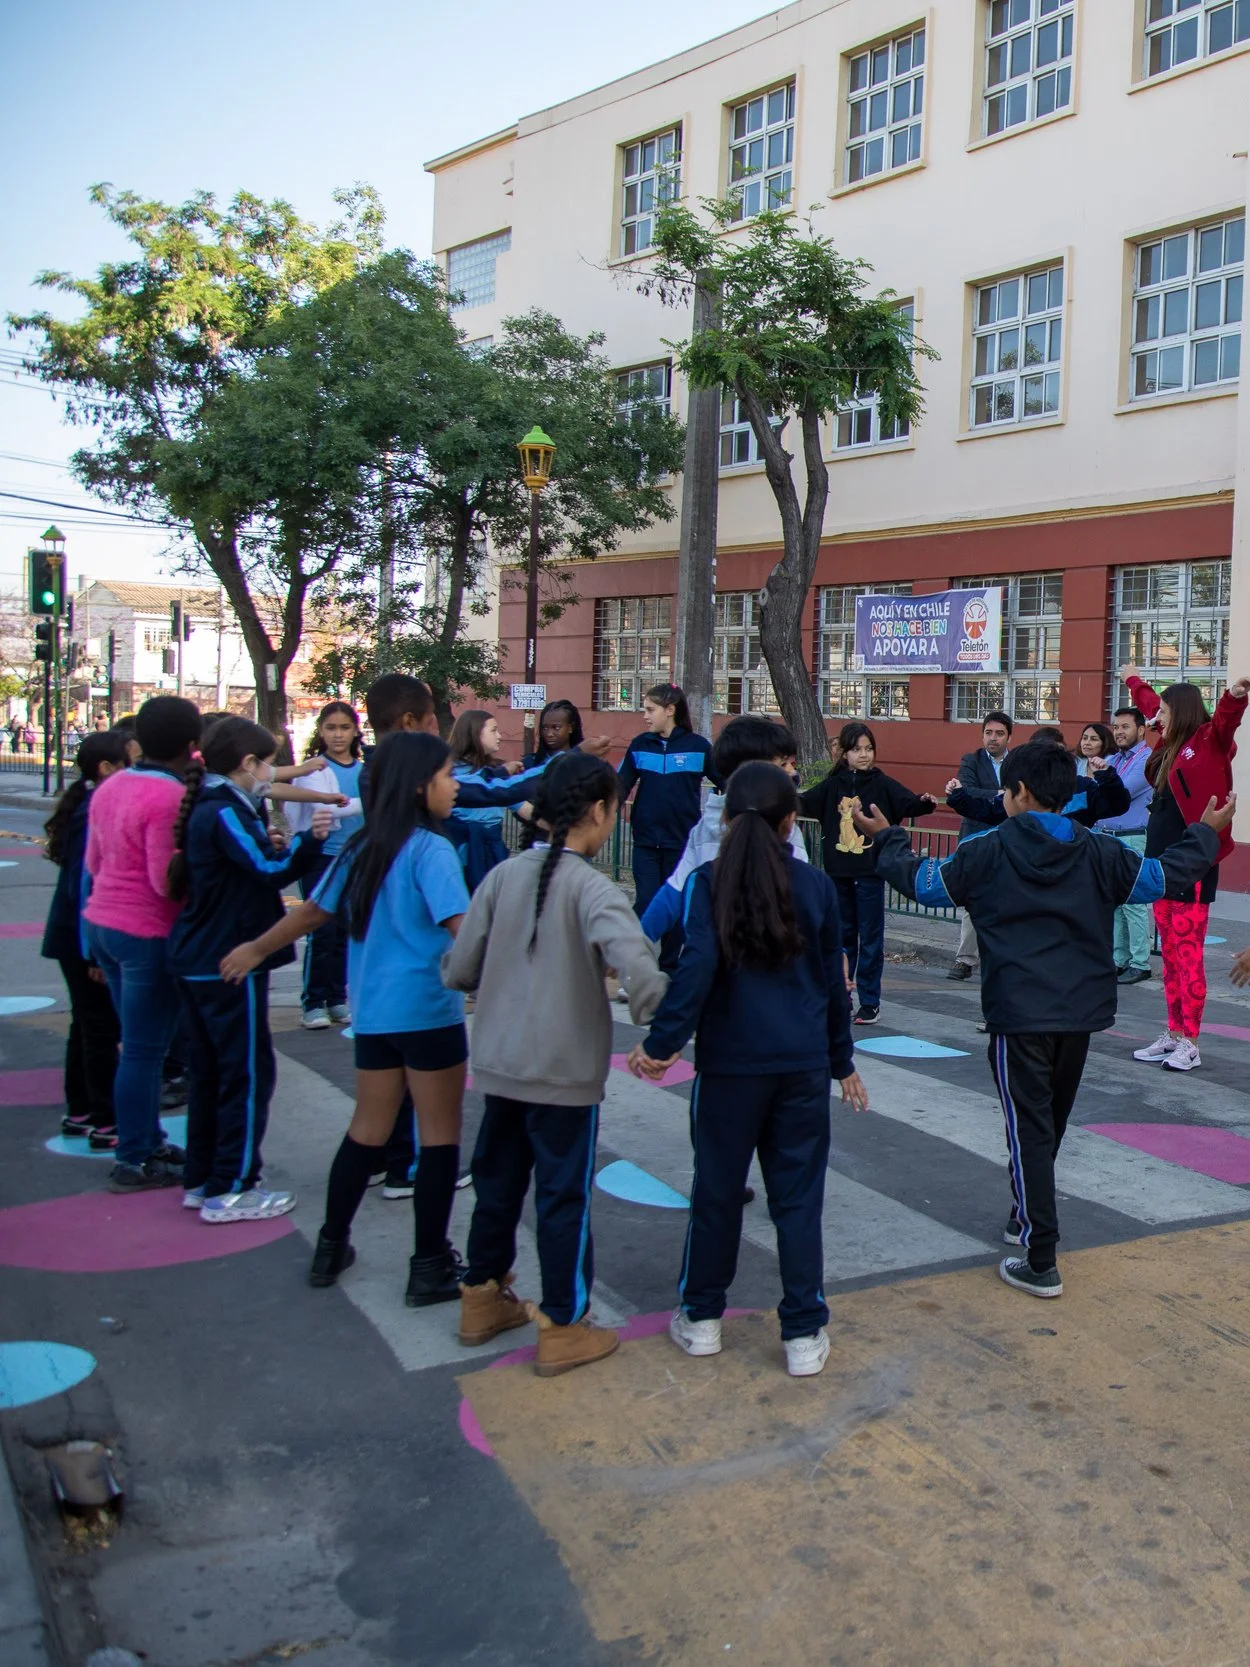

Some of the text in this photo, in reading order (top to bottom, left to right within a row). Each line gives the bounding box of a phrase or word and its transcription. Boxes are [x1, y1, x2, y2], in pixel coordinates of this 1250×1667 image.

[870, 601, 894, 619] AQUÍ
[893, 604, 903, 619] Y
[904, 604, 918, 618] EN
[919, 601, 950, 617] CHILE
[872, 619, 947, 637] NOS HACE BIEN
[873, 638, 939, 656] APOYAR A
[961, 639, 989, 652] Teletón
